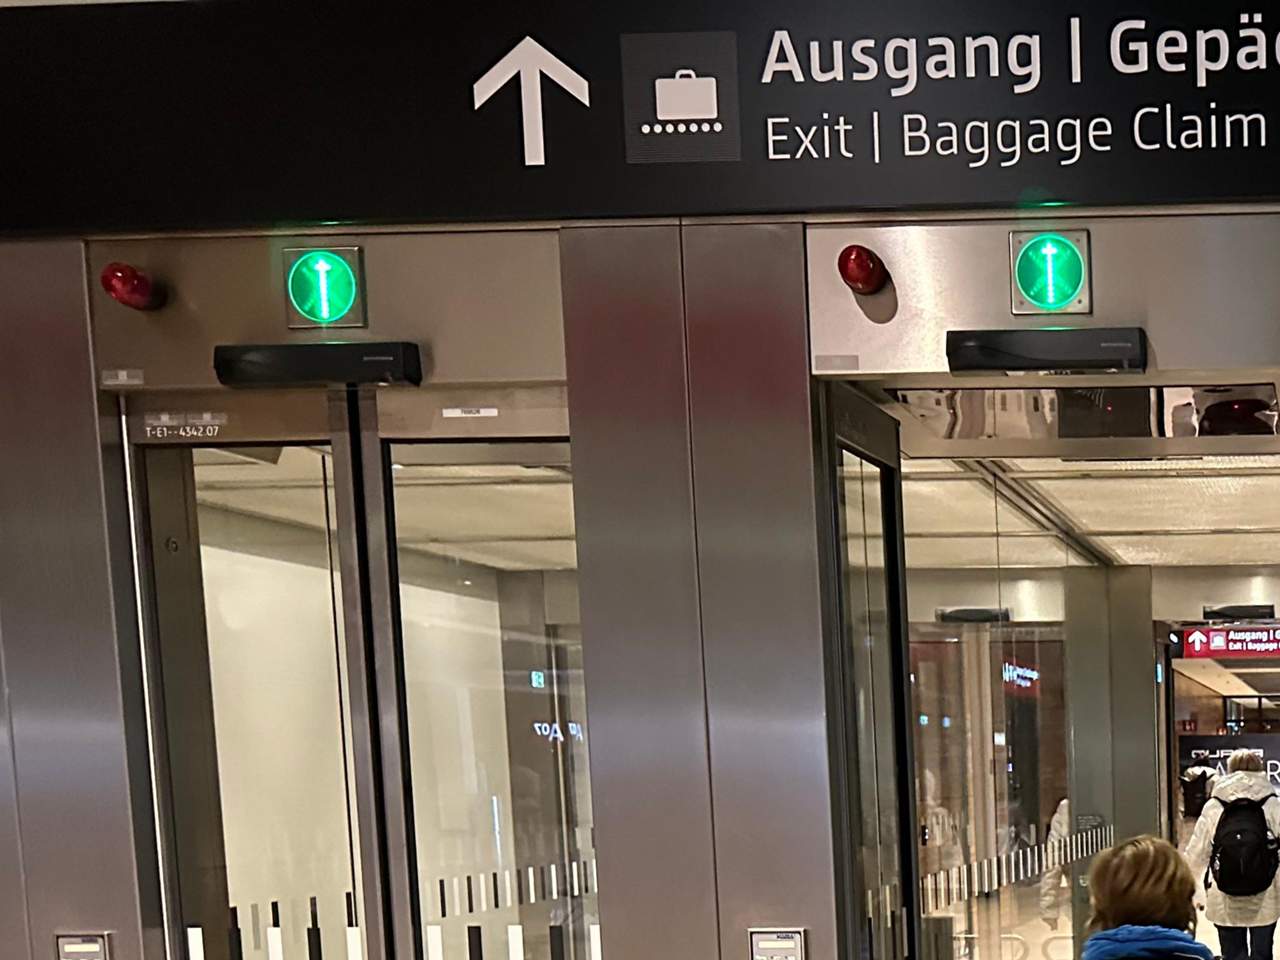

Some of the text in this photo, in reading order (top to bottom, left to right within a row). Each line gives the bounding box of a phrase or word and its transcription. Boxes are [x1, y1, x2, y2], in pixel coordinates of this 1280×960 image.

[761, 30, 1040, 97] Ausgang
[767, 113, 854, 160] Exit
[902, 114, 1113, 168] Baggage
[1133, 103, 1267, 150] Claim
[1228, 630, 1268, 642] Ausgang
